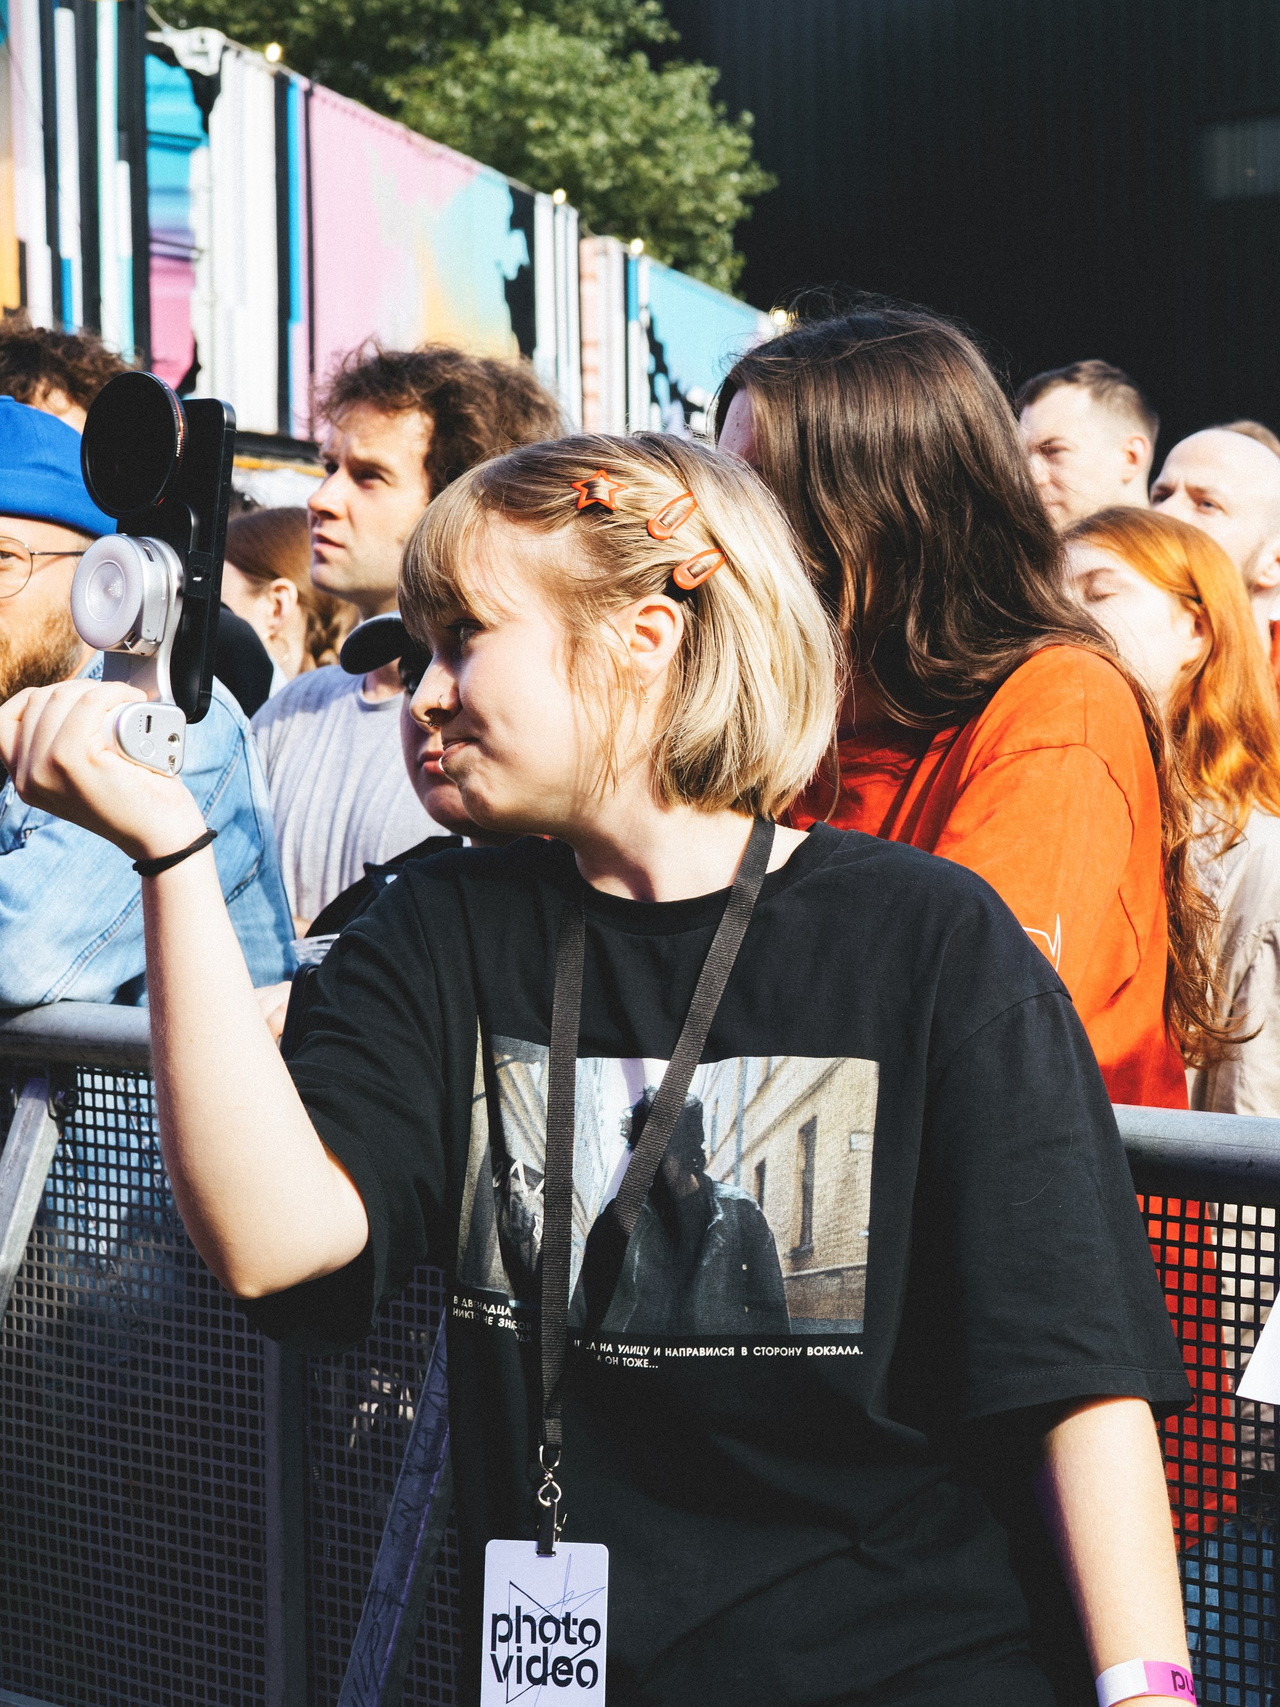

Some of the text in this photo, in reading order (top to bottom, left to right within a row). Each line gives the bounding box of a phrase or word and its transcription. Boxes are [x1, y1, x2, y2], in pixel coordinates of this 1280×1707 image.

[600, 1342, 613, 1353] НА
[618, 1344, 650, 1356] УЛИЦУ
[653, 1347, 661, 1356] И
[665, 1346, 735, 1357] НАПРАВИЛСЯ
[741, 1346, 748, 1356] В
[753, 1346, 802, 1357] СТОРОНУ
[807, 1345, 864, 1356] ВОКЗАЛА.
[604, 1355, 619, 1365] ОН
[622, 1357, 659, 1368] ТОЖЕ...
[490, 1606, 601, 1650] photo
[489, 1647, 599, 1689] video
